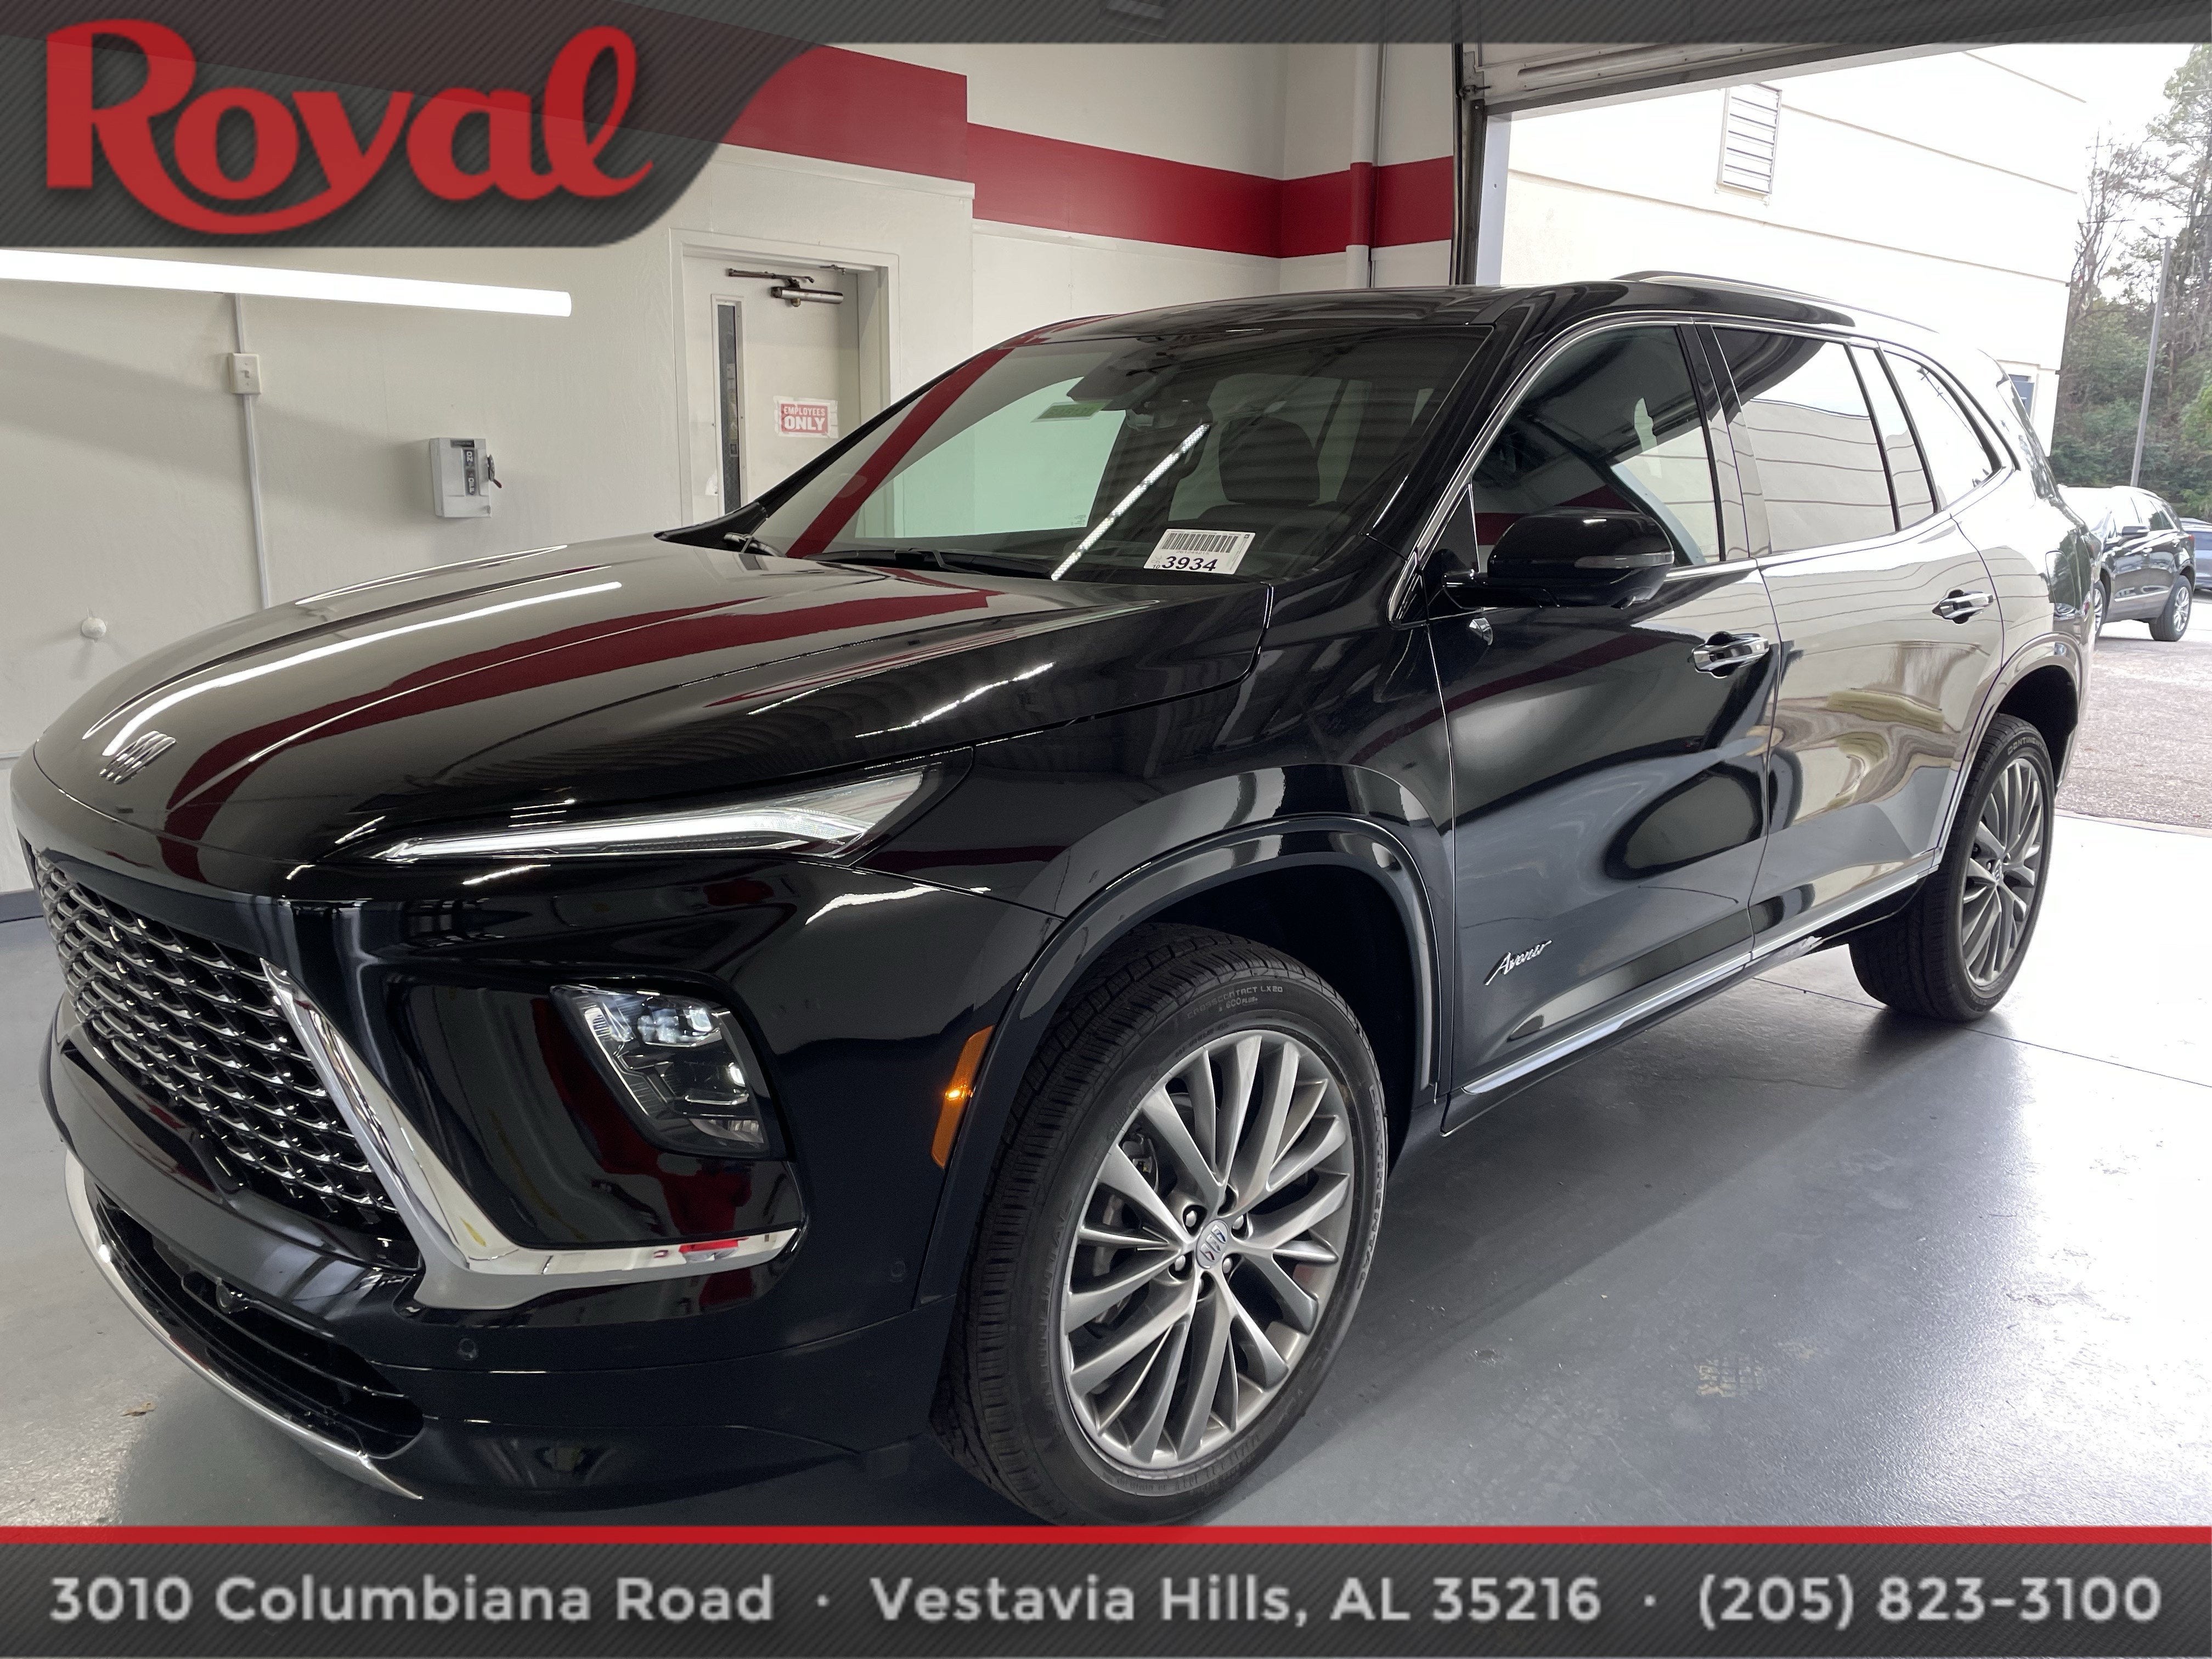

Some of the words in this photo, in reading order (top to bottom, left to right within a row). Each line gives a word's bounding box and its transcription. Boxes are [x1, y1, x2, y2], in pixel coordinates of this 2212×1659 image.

[783, 406, 826, 416] EMPLOYEES
[784, 415, 825, 431] ONLY
[1162, 556, 1218, 572] 3934
